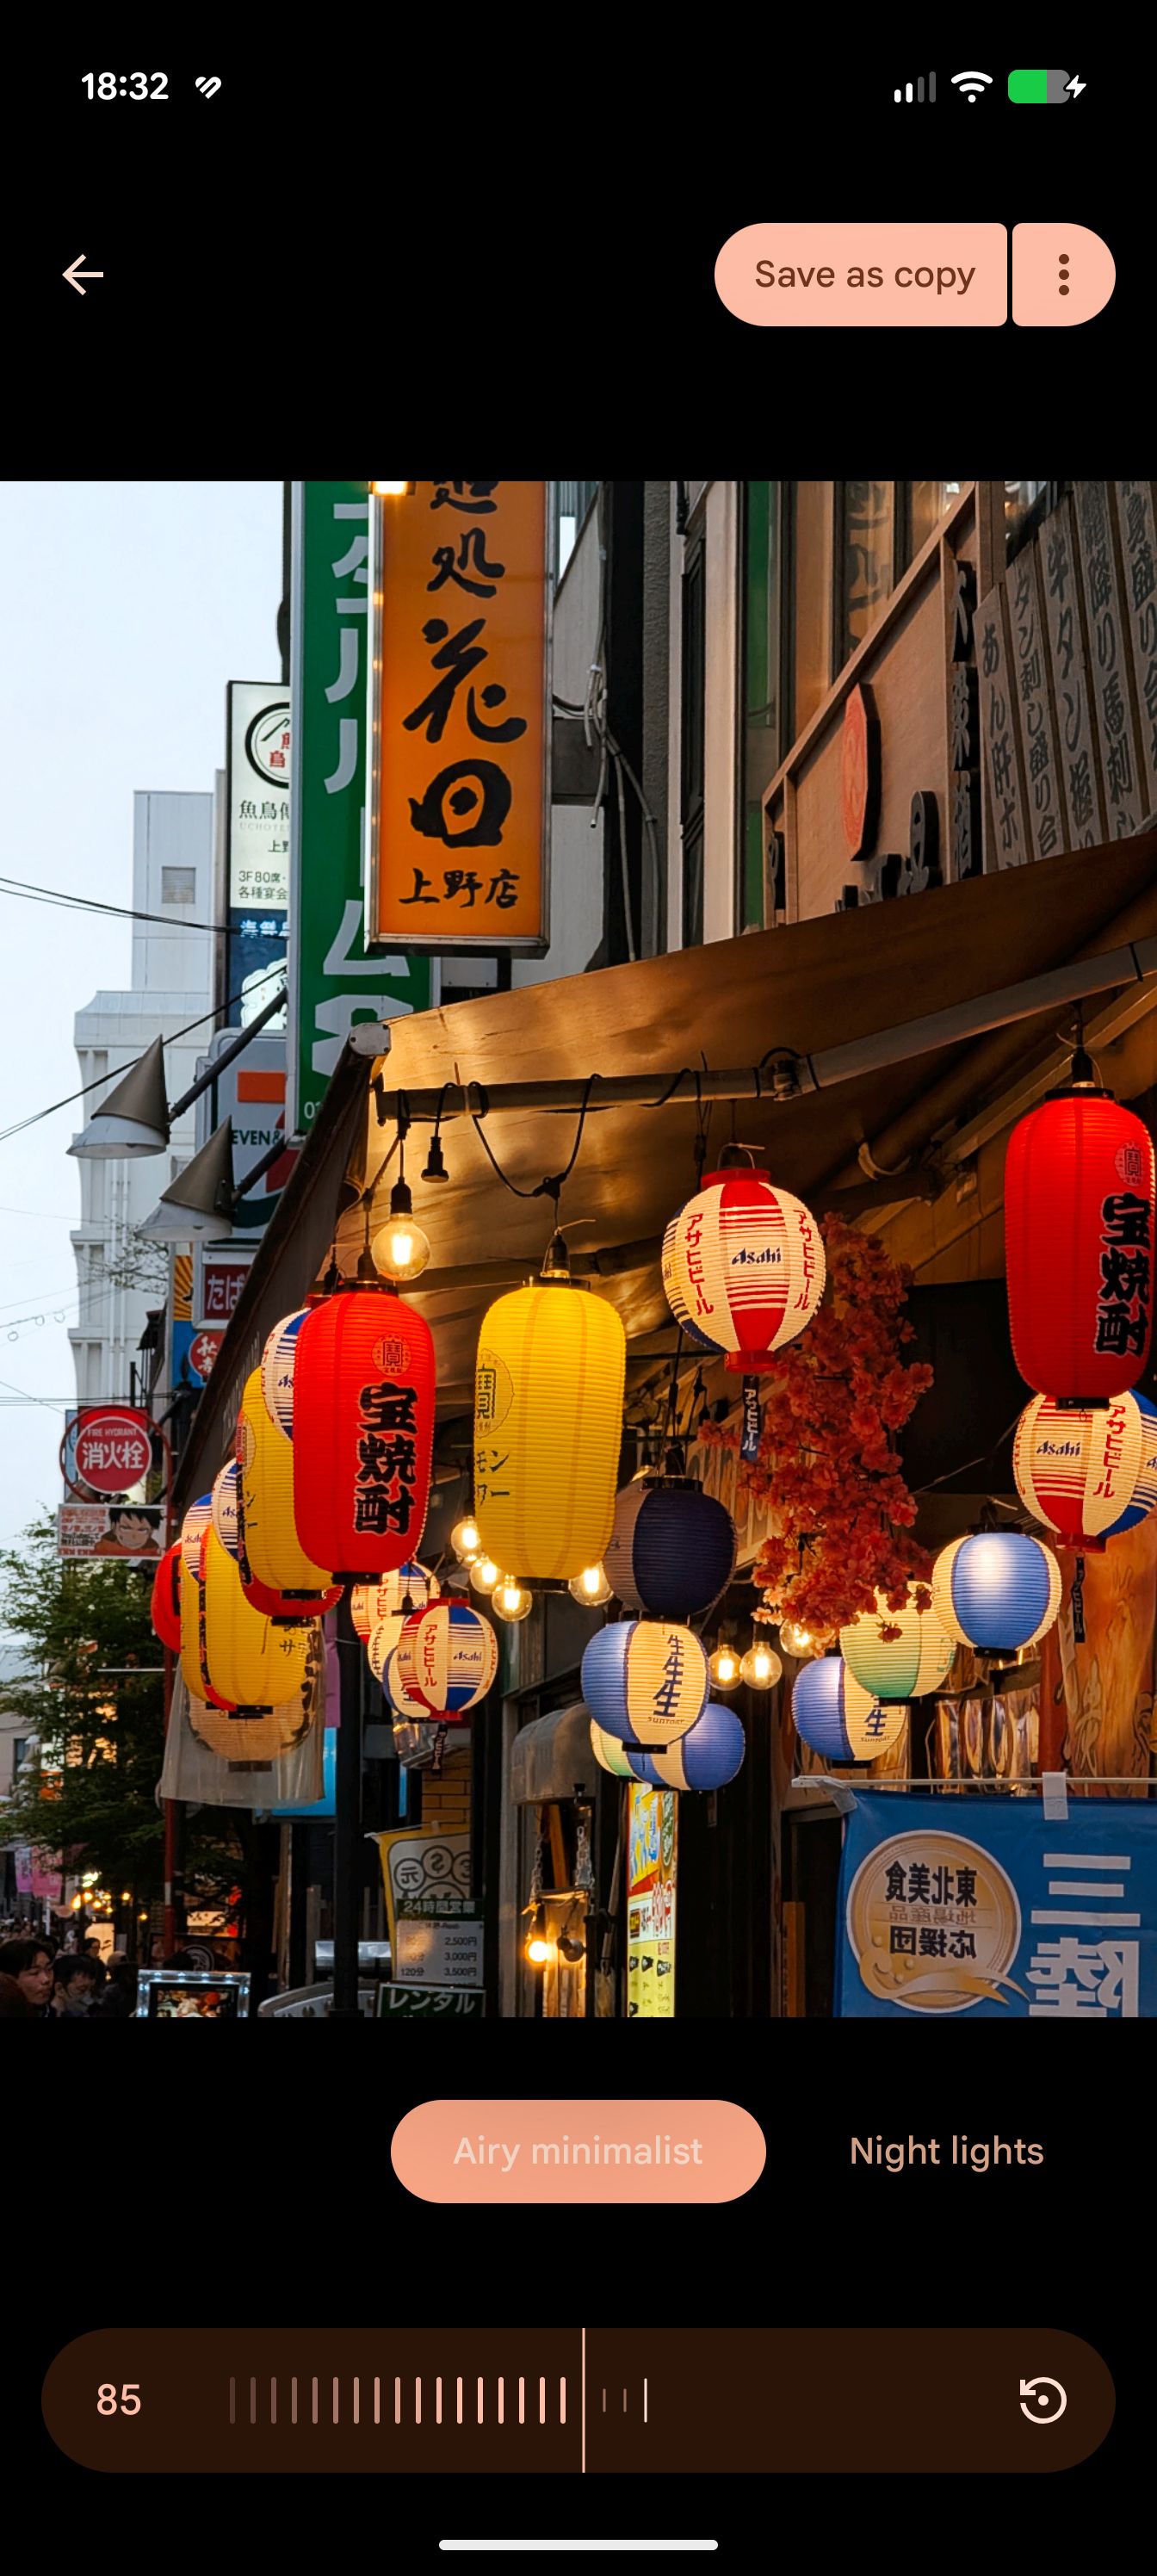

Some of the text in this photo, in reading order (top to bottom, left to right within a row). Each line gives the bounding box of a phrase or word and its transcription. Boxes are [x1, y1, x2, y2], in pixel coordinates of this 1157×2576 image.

[81, 71, 170, 101] 18:32
[755, 259, 976, 295] Save as copy
[981, 622, 1021, 868] あん肝ポ
[399, 868, 521, 910] 上野店
[684, 1212, 715, 1316] アサヒビール
[731, 1246, 782, 1266] Asahi
[793, 1209, 816, 1311] アサヒビール
[1094, 1190, 1152, 1359] 宝焼酎
[742, 1388, 758, 1452] アサヒビール
[82, 1440, 145, 1470] 消火栓
[355, 1382, 419, 1535] 宝焼酎
[1036, 1440, 1081, 1457] Asahi
[1092, 1403, 1127, 1498] アサヒビール
[424, 1624, 437, 1687] アサヒビール
[453, 1649, 483, 1663] Asahi
[652, 1633, 685, 1717] 生生生
[403, 1900, 476, 1914] 24時間営業
[400, 1967, 424, 1976] 120分
[443, 1952, 477, 1961] 3,000円
[389, 1988, 476, 2014] レンタル
[453, 2134, 703, 2173] Airy minimalist
[851, 2134, 1044, 2173] Night lights
[96, 2383, 141, 2416] 85
